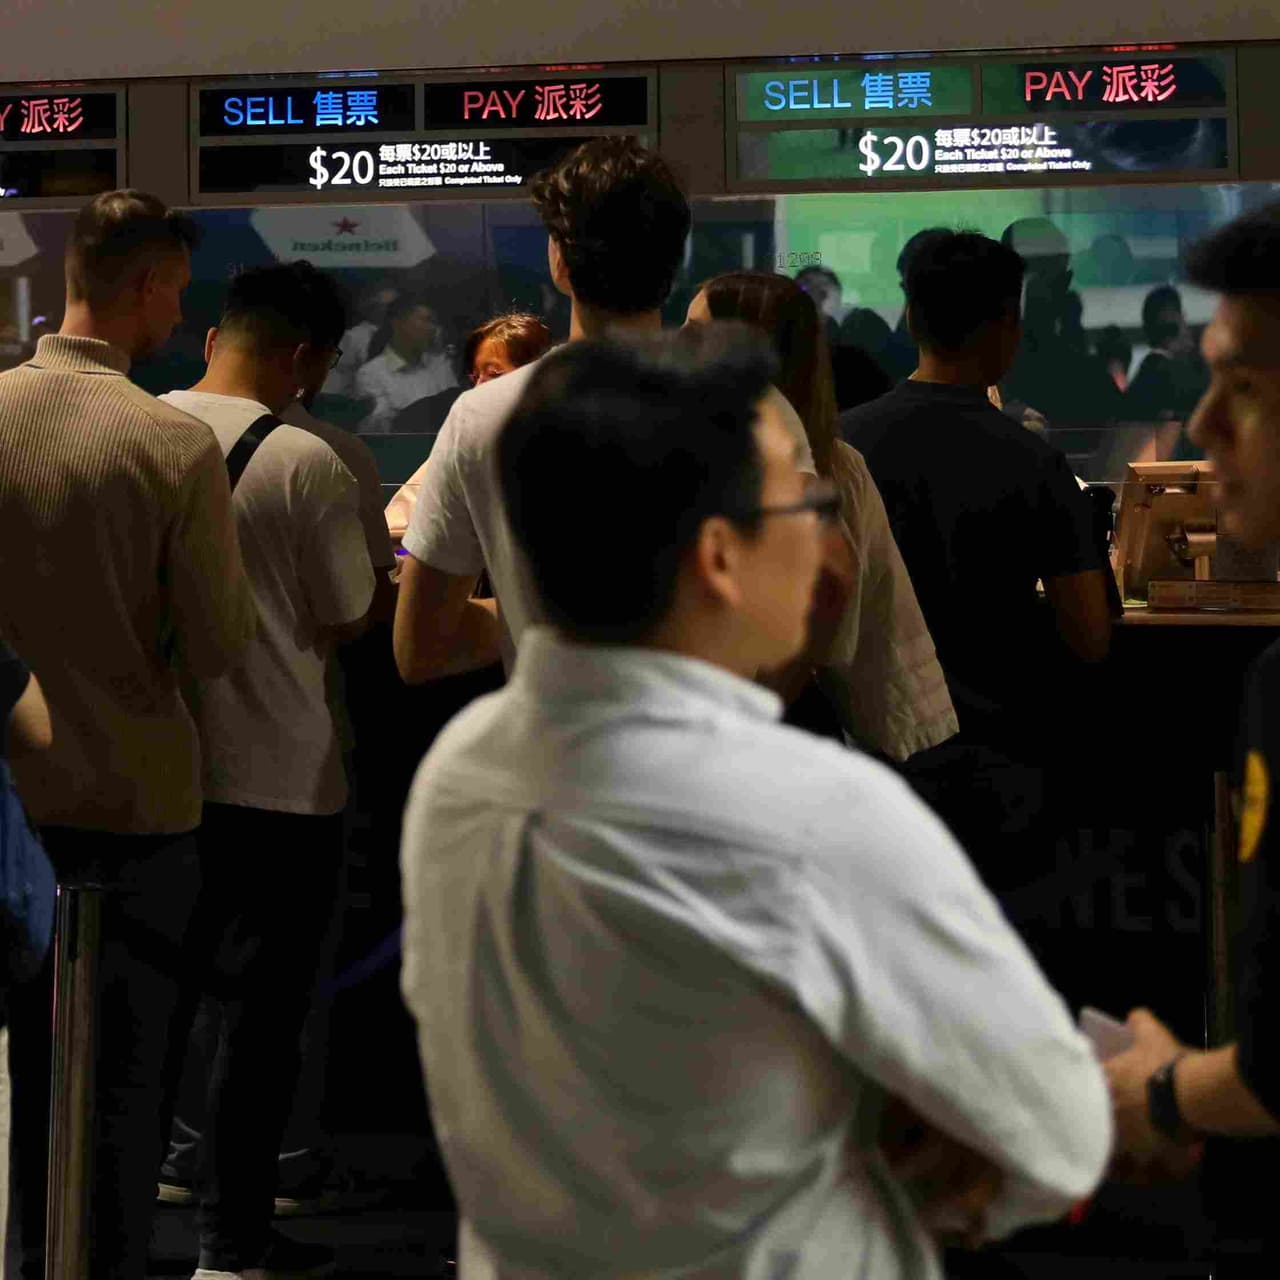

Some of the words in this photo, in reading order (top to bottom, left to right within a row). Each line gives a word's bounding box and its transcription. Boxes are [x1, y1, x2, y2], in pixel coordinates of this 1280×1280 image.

[464, 90, 525, 119] PAY
[534, 83, 602, 120] 派彩
[765, 79, 852, 110] SELL
[861, 72, 932, 110] 售票
[1025, 70, 1092, 101] PAY
[1102, 64, 1176, 102] 派彩
[21, 98, 83, 133] 派彩
[224, 97, 304, 126] SELL
[313, 91, 379, 126] 售票
[309, 146, 374, 190] $20
[379, 141, 491, 162] 每票$20或以上
[379, 164, 405, 175] Each
[406, 163, 438, 174] Ticket
[439, 162, 457, 174] $20
[458, 164, 470, 173] or
[470, 161, 504, 173] Above
[859, 131, 930, 176] $20
